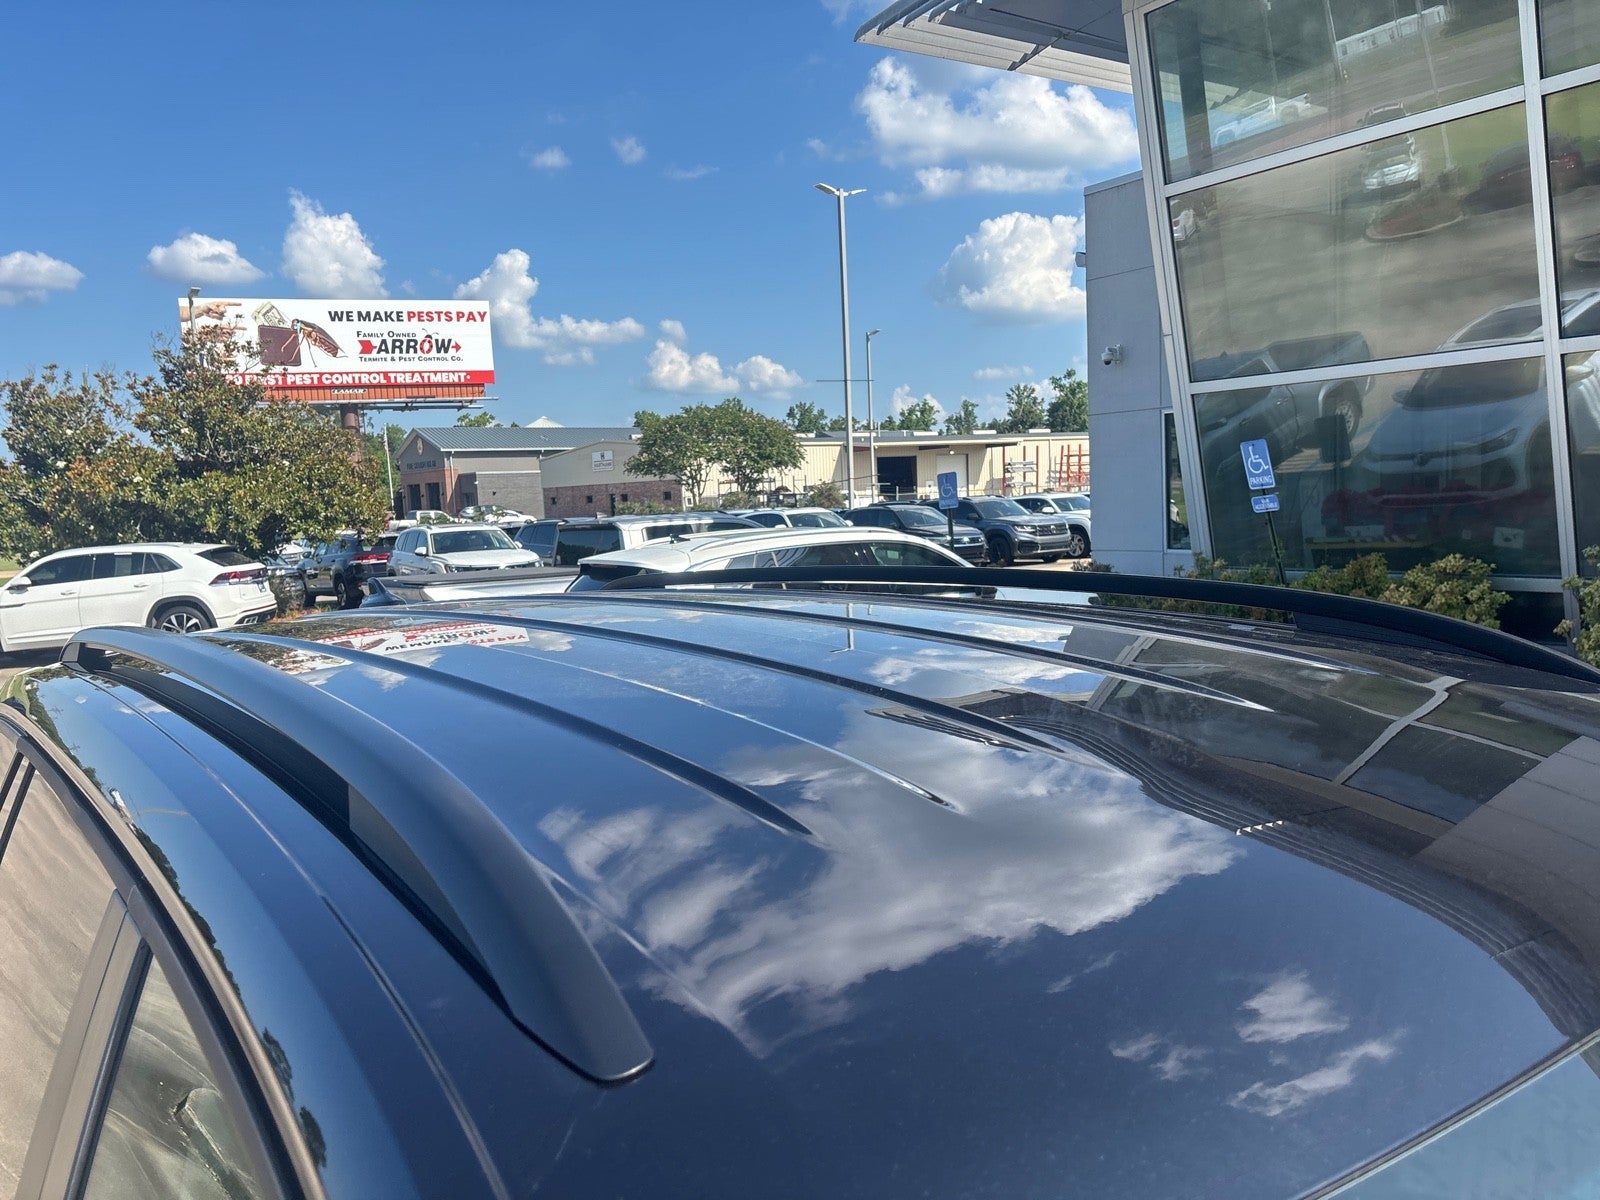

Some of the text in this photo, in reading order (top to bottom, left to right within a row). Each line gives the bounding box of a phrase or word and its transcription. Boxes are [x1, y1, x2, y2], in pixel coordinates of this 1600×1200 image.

[328, 311, 487, 322] WE MAKE PESTS PAY
[376, 338, 453, 354] ARROW
[286, 374, 320, 385] PEST
[321, 373, 387, 385] CONTROL
